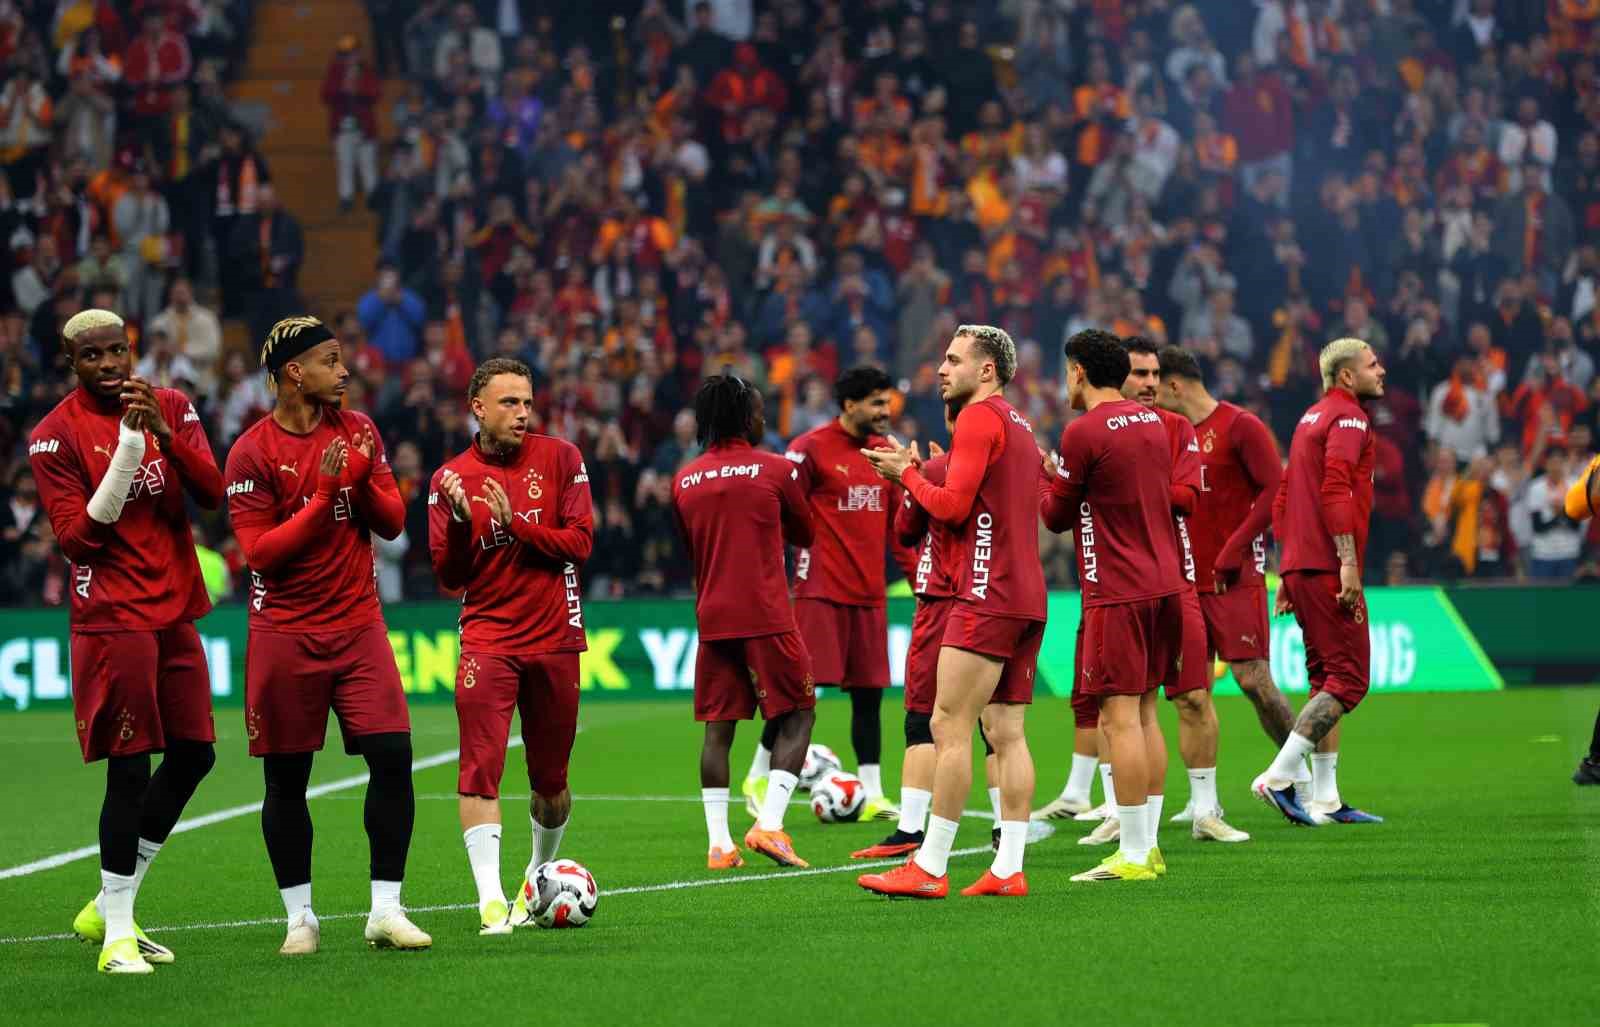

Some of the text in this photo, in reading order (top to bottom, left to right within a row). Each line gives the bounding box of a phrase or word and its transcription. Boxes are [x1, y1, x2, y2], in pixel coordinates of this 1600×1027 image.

[1106, 414, 1129, 431] CW
[681, 471, 703, 489] CW
[847, 484, 882, 499] NEXT
[837, 496, 885, 512] LEVEL
[1079, 500, 1099, 584] ALFEMO
[915, 531, 933, 594] LFEMO
[970, 511, 994, 601] ALFEMO
